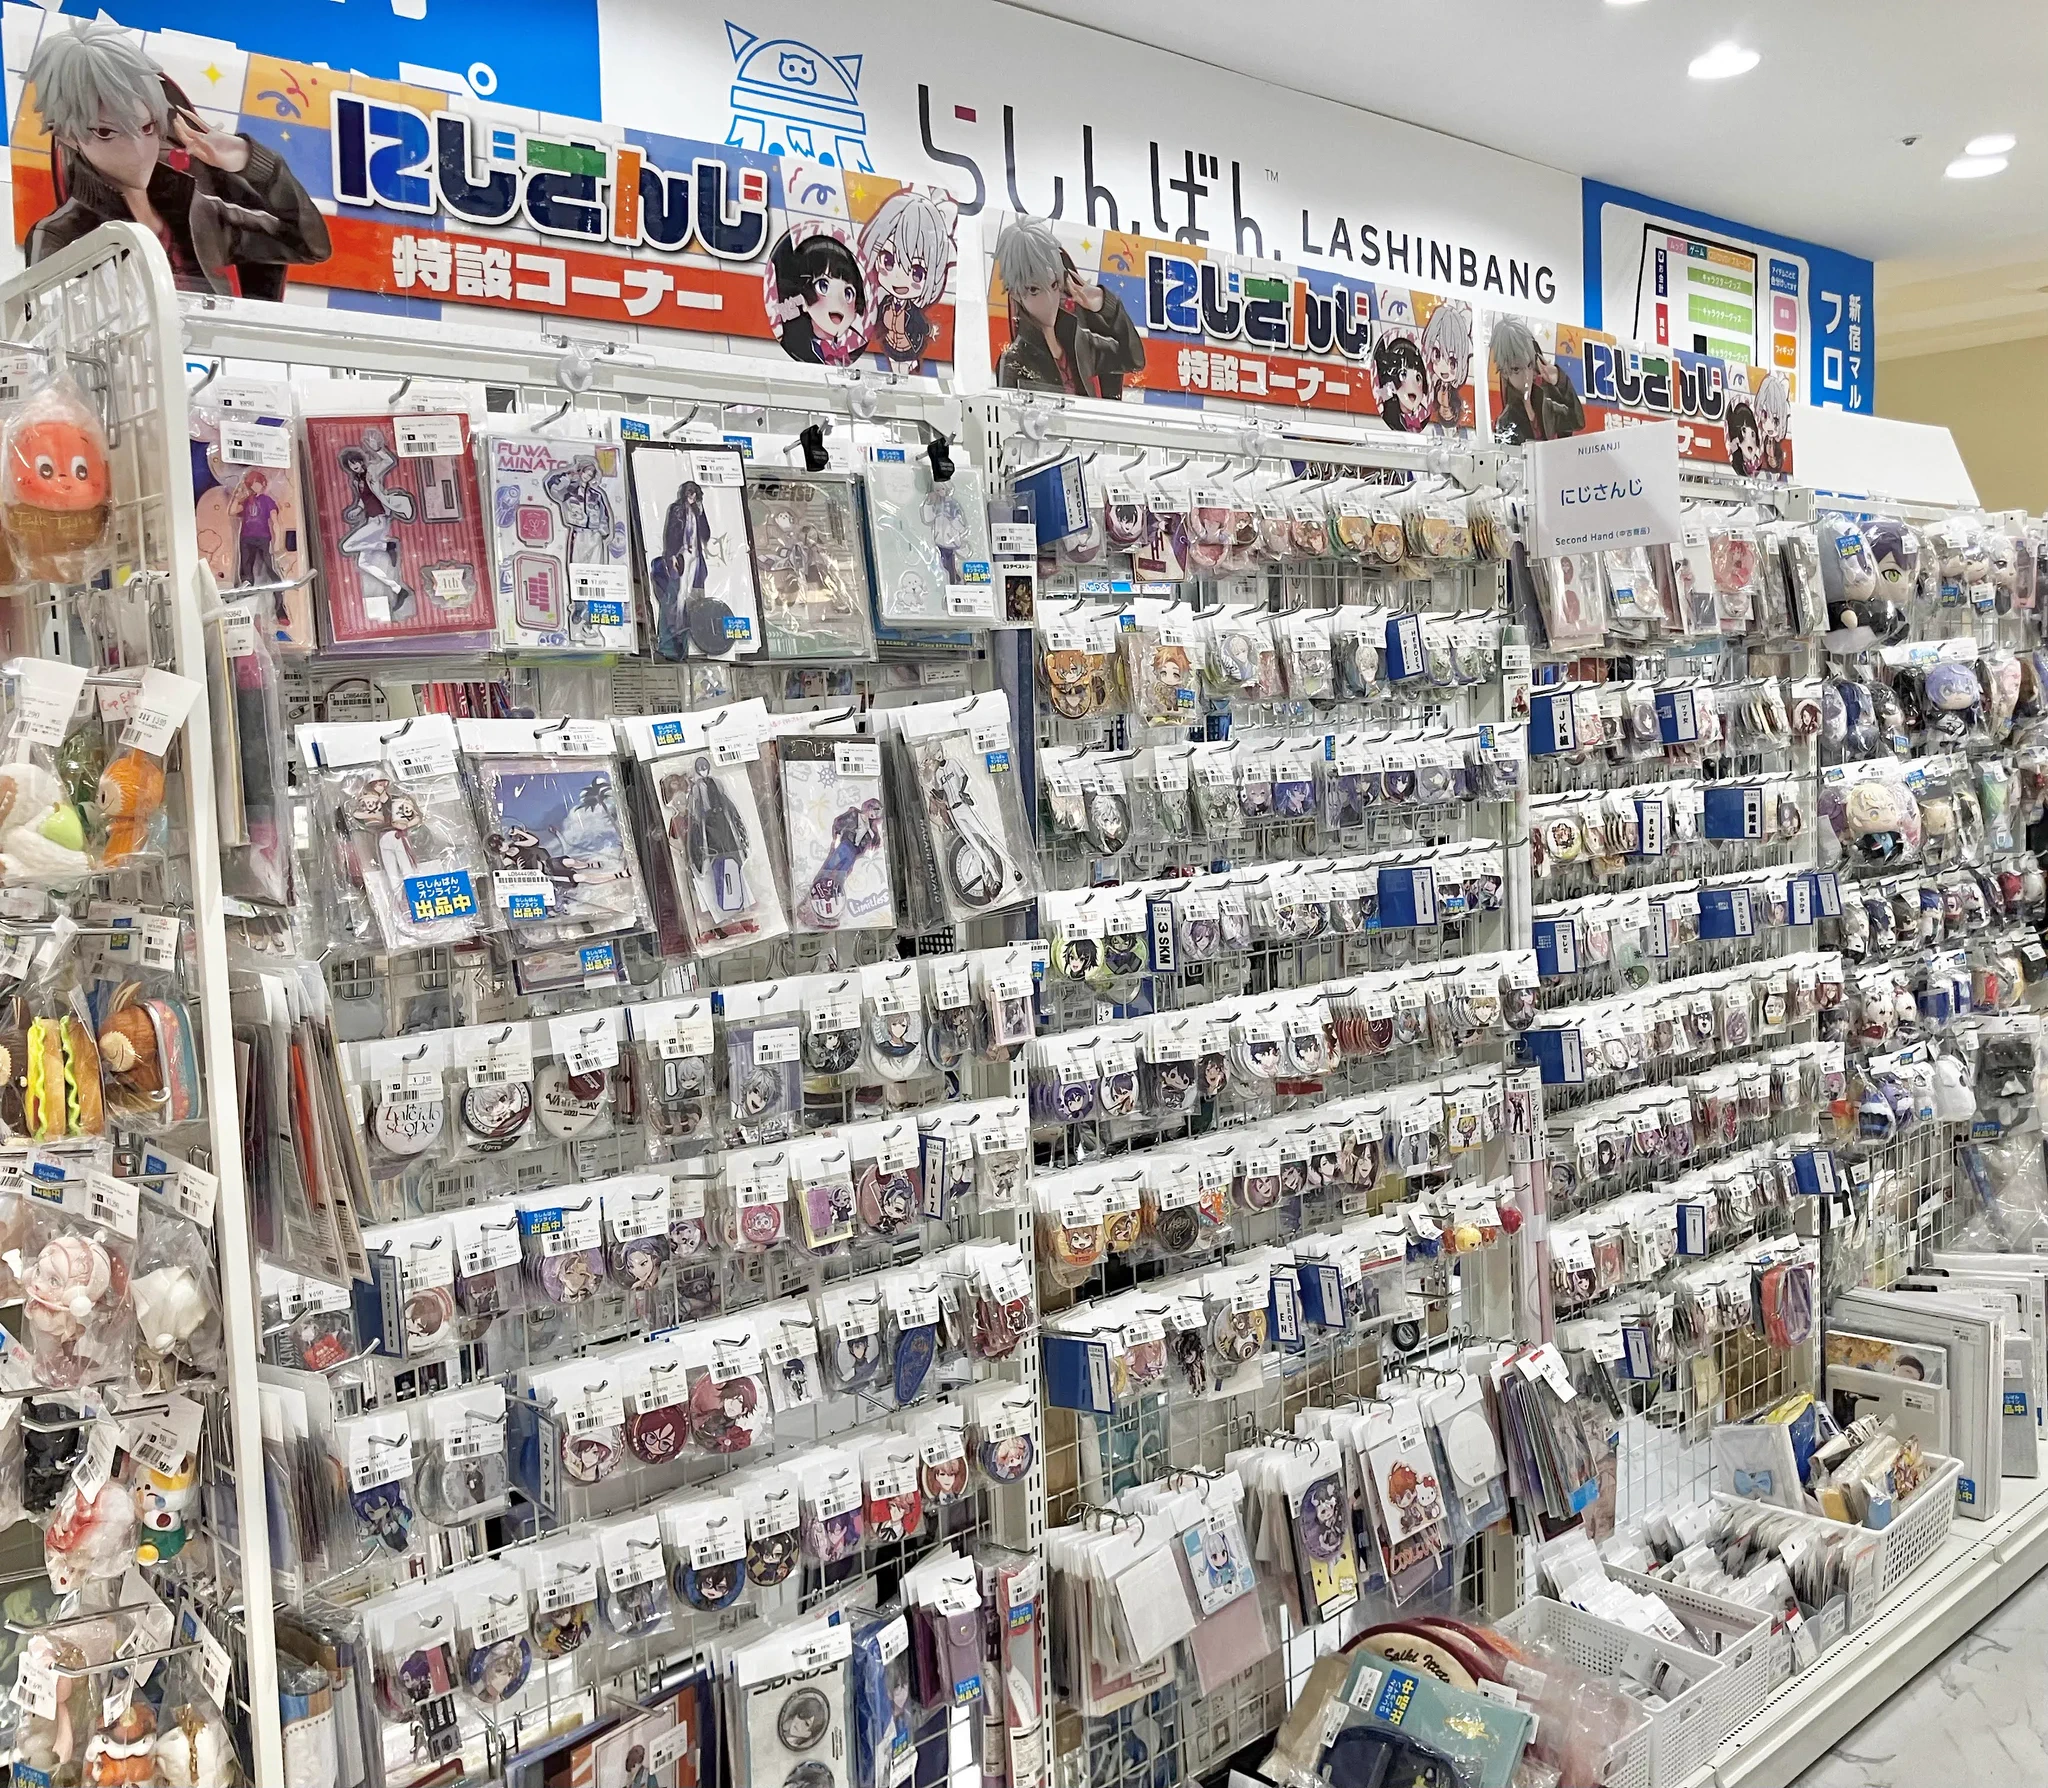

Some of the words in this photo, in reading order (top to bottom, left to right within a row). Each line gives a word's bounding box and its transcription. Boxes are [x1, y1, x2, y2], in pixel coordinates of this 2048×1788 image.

[332, 92, 769, 258] にじさんじ
[918, 84, 1281, 261] らしんばん
[1301, 209, 1558, 306] LASHINBANG
[392, 234, 724, 318] 特設コーナー
[1702, 273, 1742, 290] キャラクターグッズ
[1146, 250, 1371, 356] にじさんじ
[1702, 308, 1742, 323] キャラクターグッズ
[1177, 350, 1350, 402] 特設コーナー
[1582, 339, 1724, 420] にじさんじ
[498, 443, 551, 458] FUWA
[1578, 442, 1620, 456] NIJISANJI
[1561, 478, 1643, 506] にじさんじ
[1555, 534, 1588, 546] Second
[1590, 531, 1614, 541] Hand
[590, 614, 619, 624] 出品中
[726, 629, 749, 639] 出品中
[656, 733, 682, 744] 出品中
[416, 877, 459, 888] らしんばん
[418, 885, 461, 899] オンライン
[414, 894, 472, 919] 出品中
[850, 891, 890, 914] Limitless
[513, 907, 543, 918] 出品中
[584, 958, 613, 971] 出品中
[530, 1220, 561, 1234] 出品中
[1280, 1313, 1287, 1333] EN
[1389, 1679, 1414, 1726] 出品中
